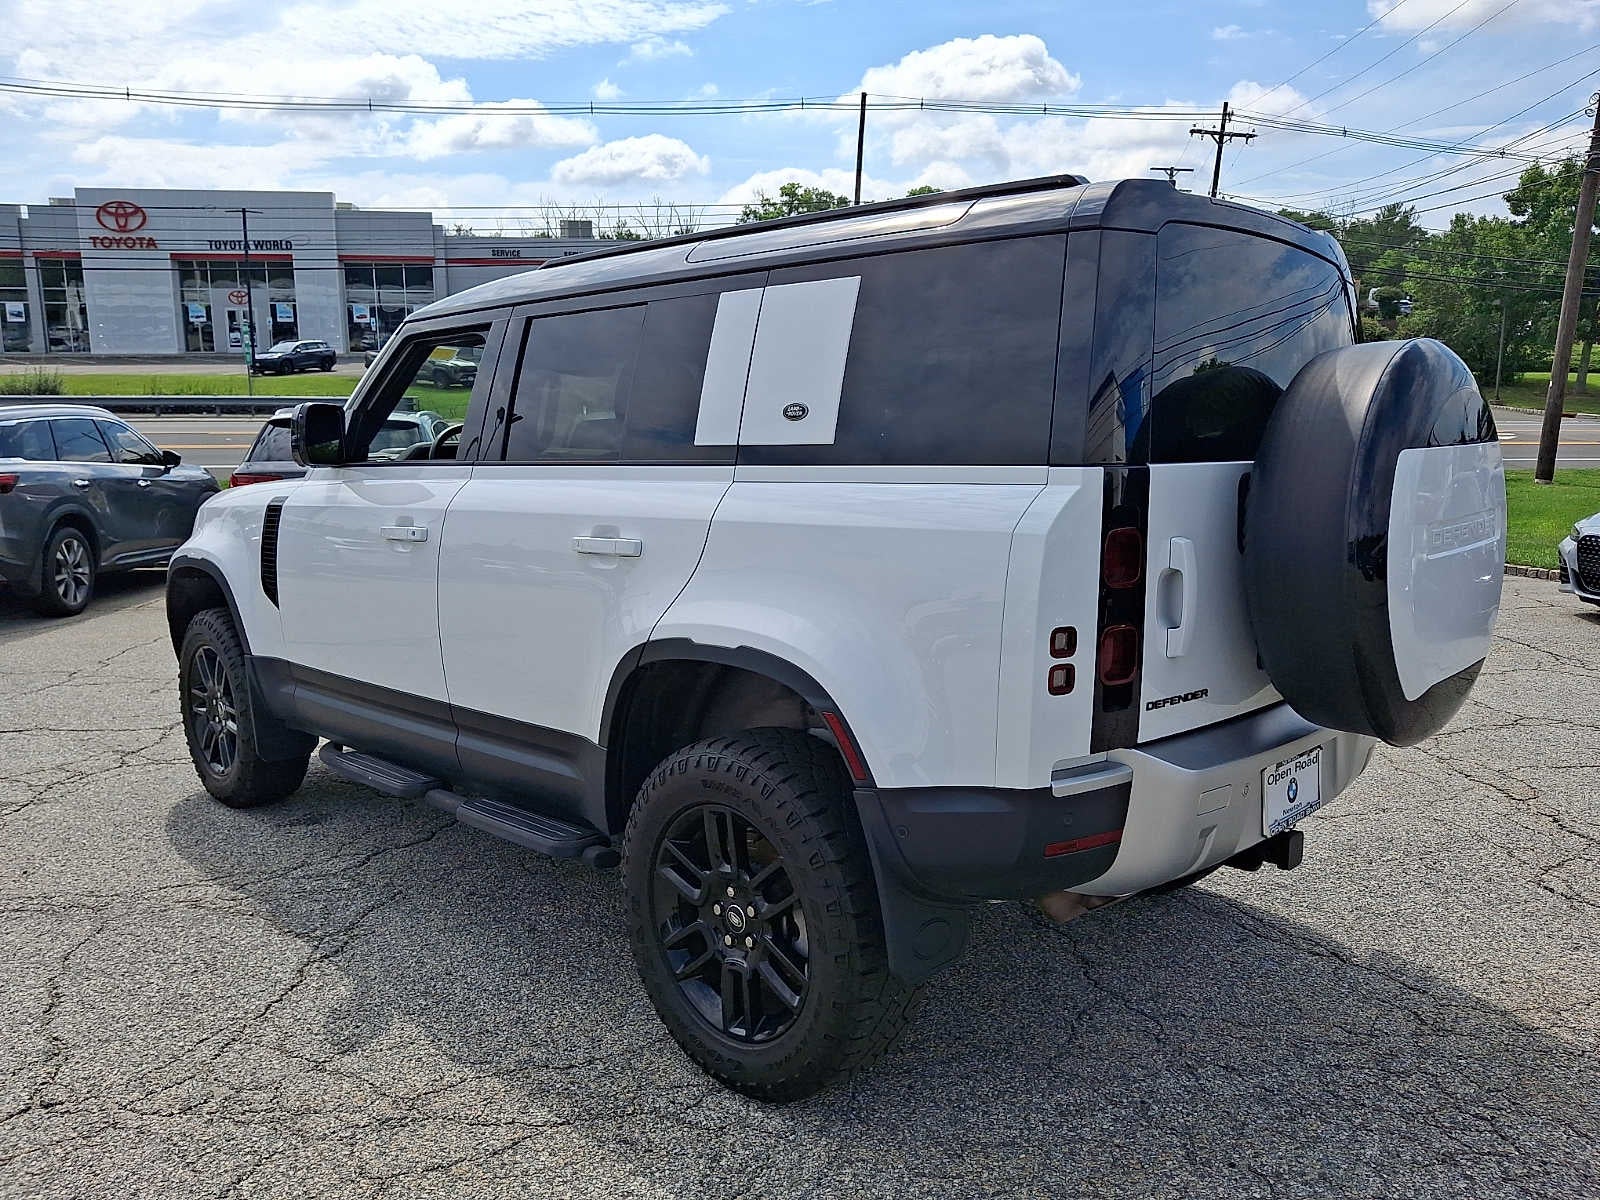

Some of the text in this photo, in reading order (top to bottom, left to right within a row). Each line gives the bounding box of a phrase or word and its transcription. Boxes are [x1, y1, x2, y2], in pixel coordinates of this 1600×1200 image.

[89, 236, 158, 249] TOYOTA
[208, 239, 293, 251] TOYOTA WORLD
[491, 249, 521, 257] SERVICE
[1145, 688, 1209, 711] DEFENDER
[1267, 767, 1292, 786] Open
[1294, 752, 1318, 773] Road
